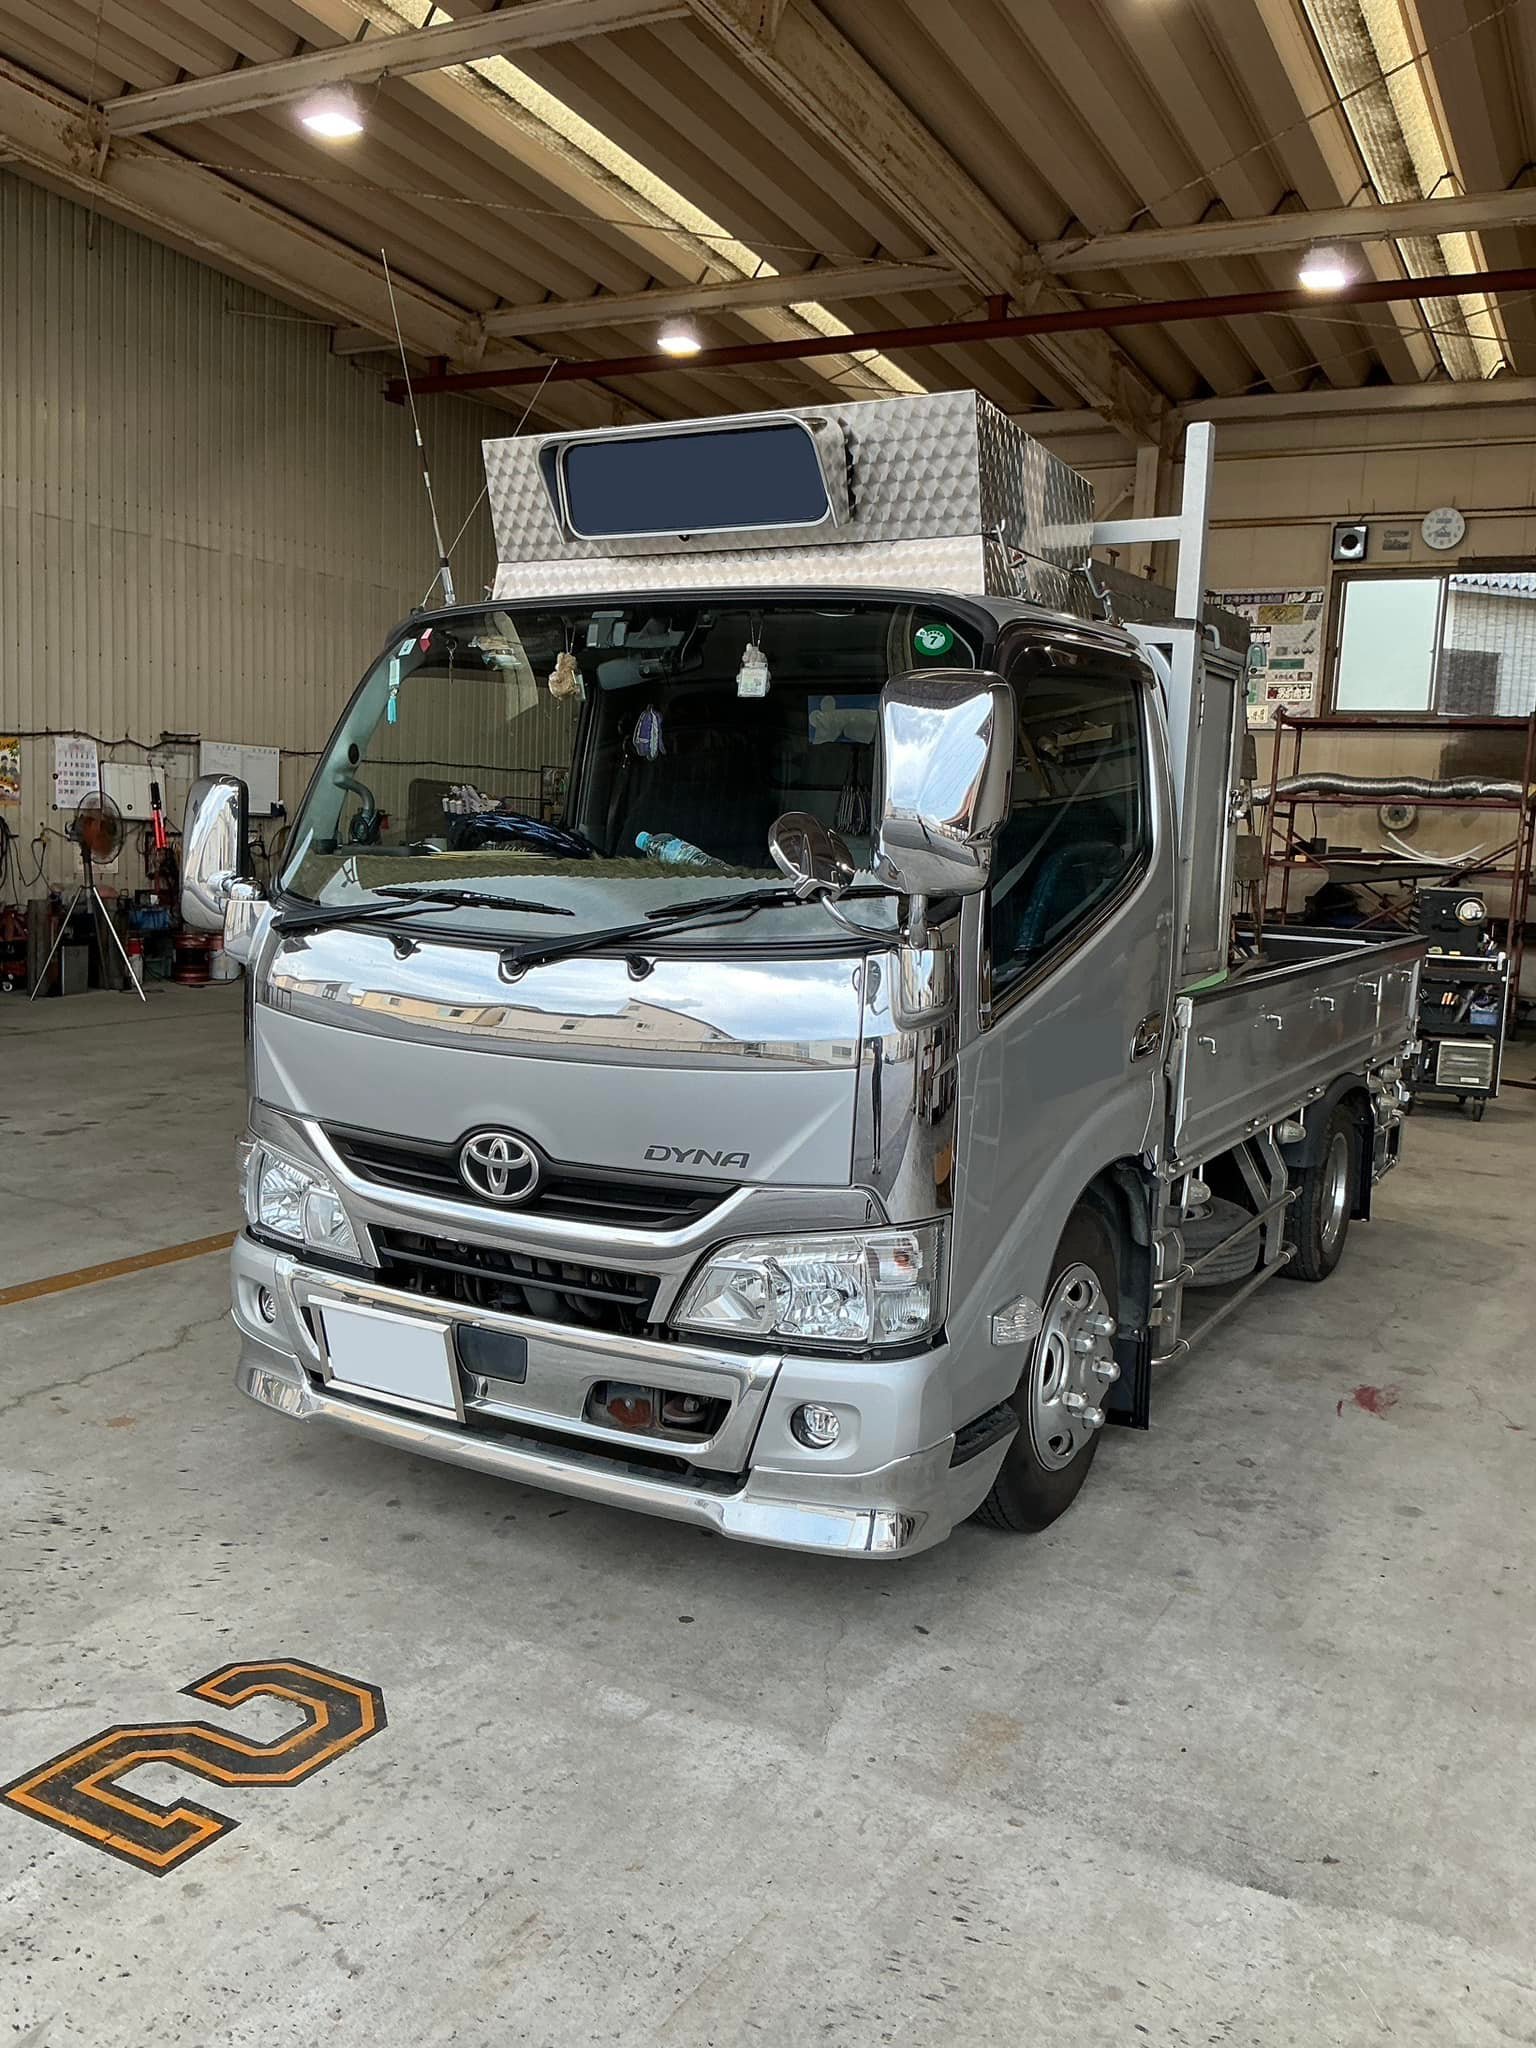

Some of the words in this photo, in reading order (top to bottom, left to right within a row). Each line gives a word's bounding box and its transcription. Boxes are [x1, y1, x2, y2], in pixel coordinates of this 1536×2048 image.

[930, 635, 938, 645] 7
[643, 1144, 750, 1169] DYNA
[0, 1657, 389, 1879] 2
